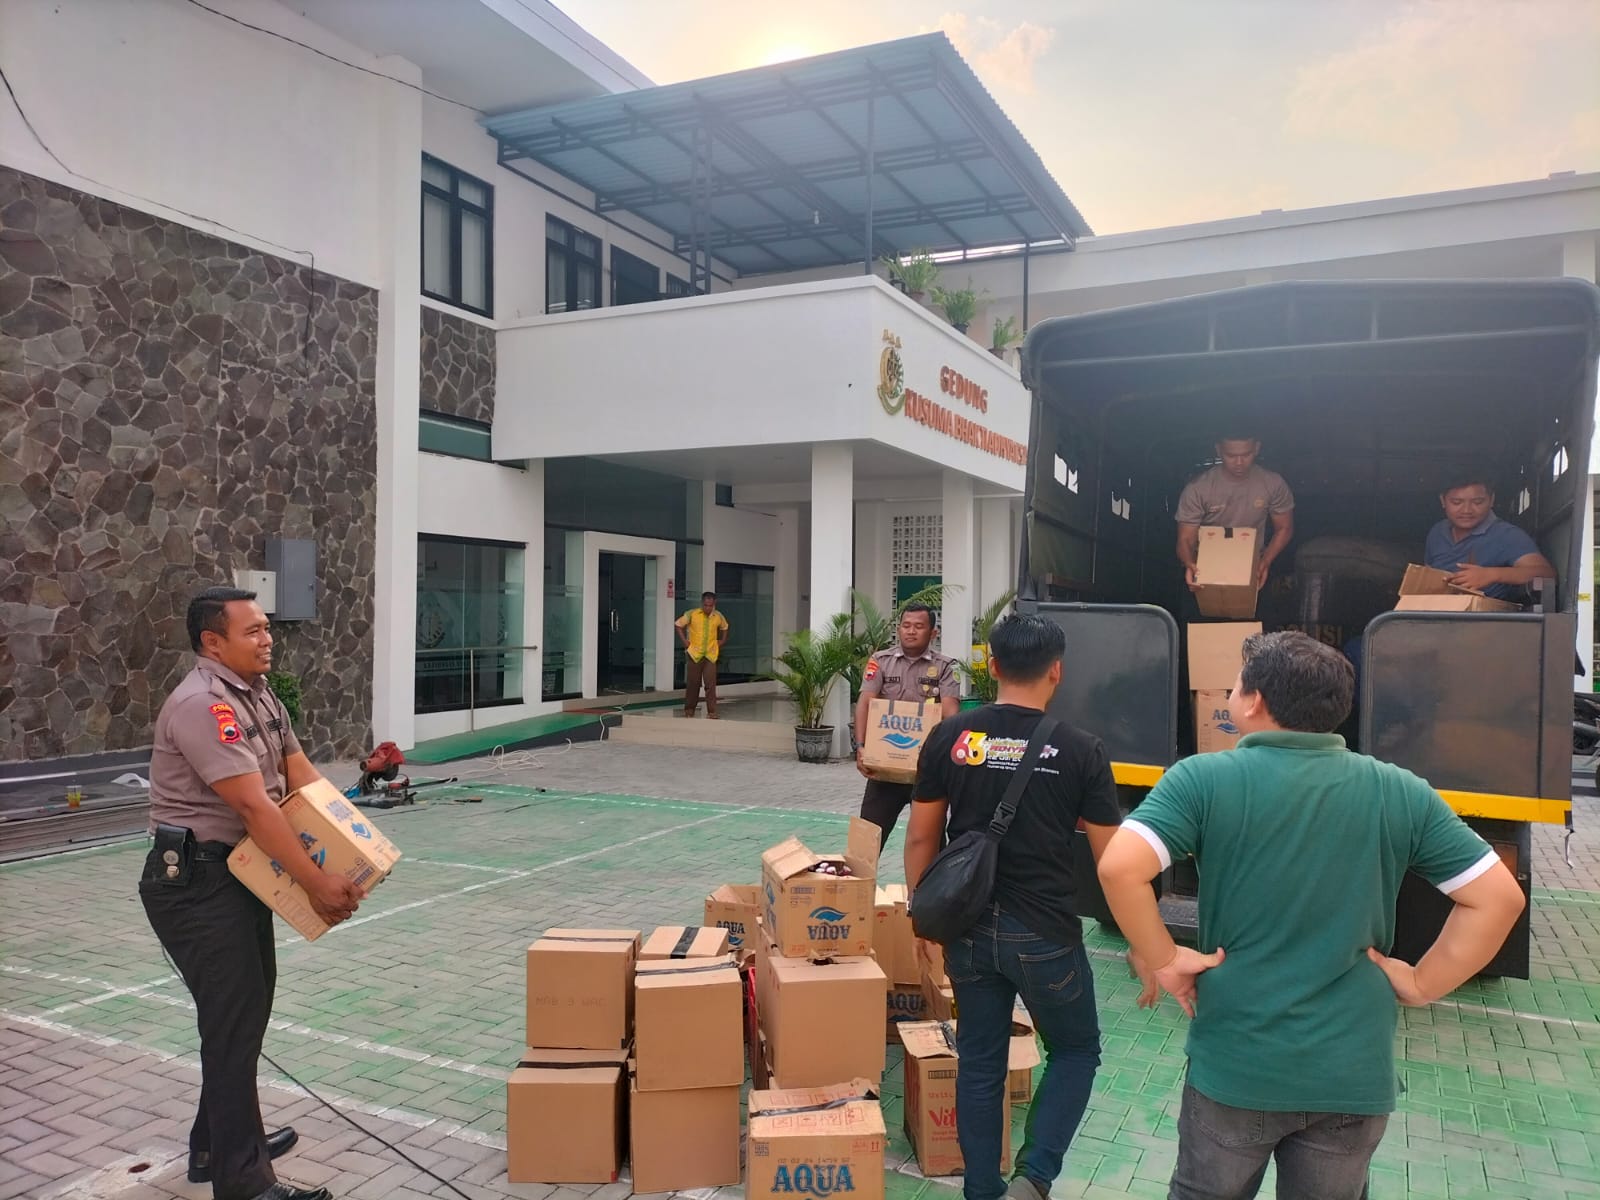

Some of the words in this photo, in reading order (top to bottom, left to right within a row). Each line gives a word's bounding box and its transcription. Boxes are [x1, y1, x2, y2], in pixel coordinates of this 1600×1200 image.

[940, 365, 988, 414] GEDUNG
[905, 387, 953, 438] KUSUMA
[878, 714, 923, 733] AQUA
[1211, 708, 1235, 725] AQ
[716, 920, 745, 936] AQUA
[807, 922, 852, 941] AQUA
[770, 1163, 856, 1198] AQUA
